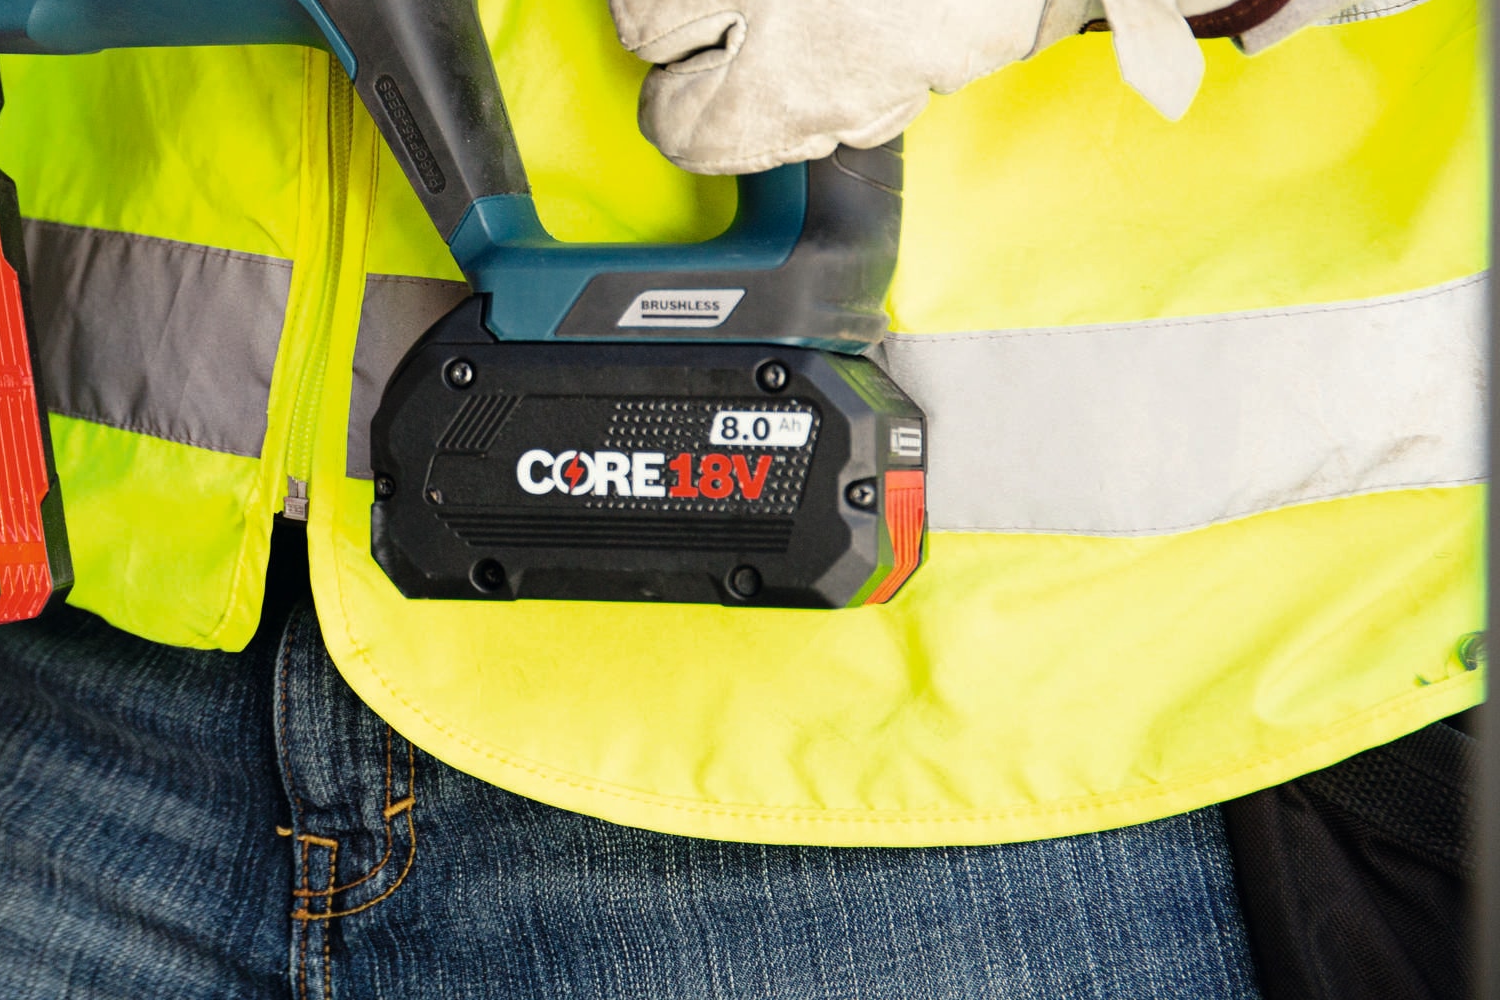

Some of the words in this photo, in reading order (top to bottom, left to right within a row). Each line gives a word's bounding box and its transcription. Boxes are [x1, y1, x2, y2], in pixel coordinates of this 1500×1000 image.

[640, 300, 721, 311] BRUSHLESS
[721, 416, 771, 441] 8.0
[779, 417, 802, 432] Ah
